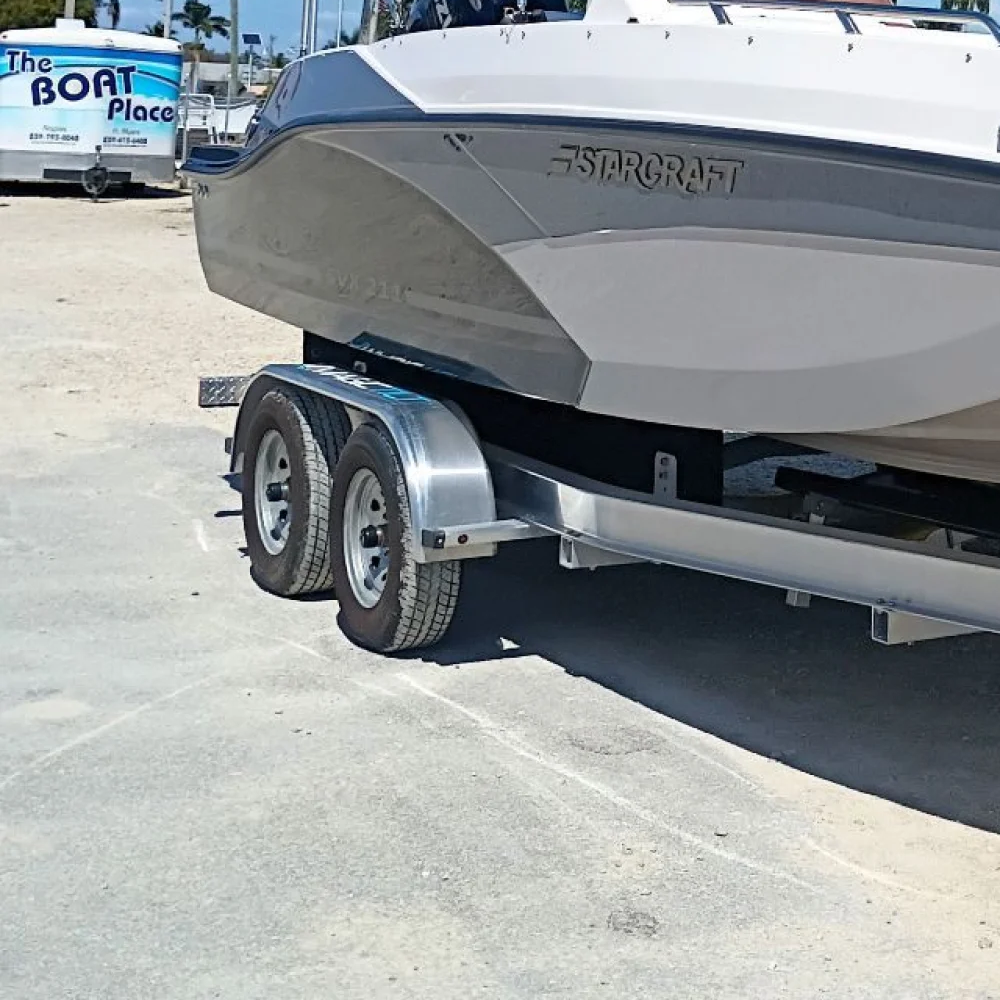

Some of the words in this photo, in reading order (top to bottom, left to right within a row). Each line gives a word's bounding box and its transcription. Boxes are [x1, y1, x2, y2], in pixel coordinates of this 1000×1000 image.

[7, 50, 52, 73] The
[31, 66, 136, 106] BOAT
[108, 98, 174, 122] Place
[577, 146, 745, 195] STARCRAFT
